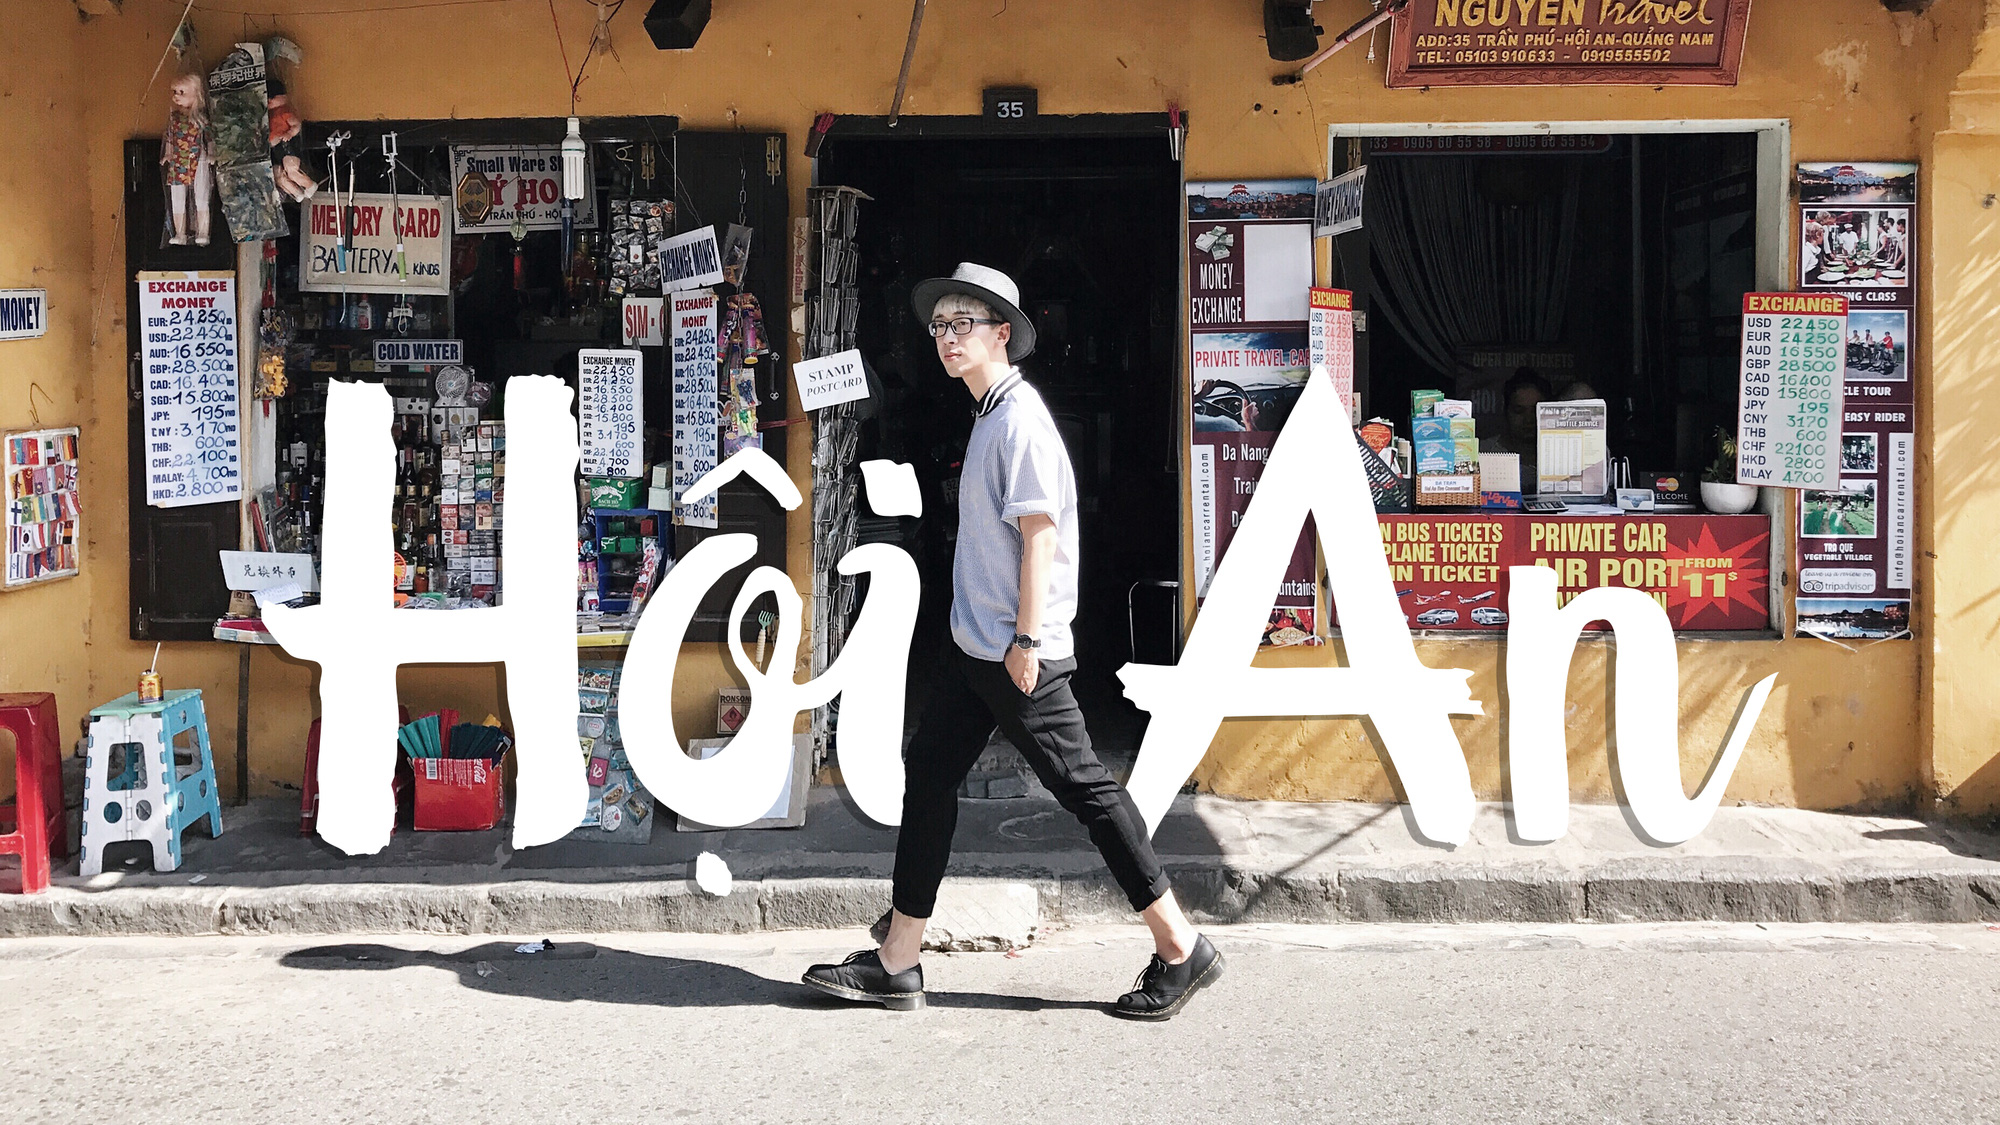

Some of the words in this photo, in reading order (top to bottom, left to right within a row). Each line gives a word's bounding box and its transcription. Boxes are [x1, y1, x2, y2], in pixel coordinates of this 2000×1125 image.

[1477, 27, 1518, 47] TRẦN
[1680, 32, 1713, 46] NAM
[1416, 51, 1450, 63] TEL:
[1455, 51, 1498, 63] 05103
[1501, 50, 1555, 63] 910633
[1581, 50, 1670, 62] 0919555502
[997, 101, 1024, 118] 35
[1457, 137, 1472, 148] 55
[1477, 136, 1492, 148] 58
[467, 157, 504, 173] Small
[508, 156, 546, 173] Ware
[392, 207, 440, 238] CARD
[312, 244, 393, 274] BATERY
[691, 238, 719, 275] MONEY
[1200, 263, 1234, 290] MONEY
[148, 281, 228, 293] EXCHANGE
[161, 297, 216, 309] MONEY
[675, 297, 713, 311] EXCHANGE
[1312, 290, 1351, 309] EXCHANGE
[1865, 291, 1897, 302] CLASS
[1192, 297, 1242, 324] EXCHANGE
[1748, 296, 1844, 313] EXCHANGE
[0, 297, 40, 331] MONEY
[625, 304, 648, 339] SIM
[681, 315, 708, 328] MONEY
[1747, 317, 1772, 328] USD
[1781, 317, 1840, 332] 22450
[1747, 331, 1771, 341] EUR
[1780, 332, 1840, 345] 24250
[378, 343, 410, 360] COLD
[412, 343, 459, 360] WATER
[1195, 350, 1240, 368] PRIVATE
[1244, 348, 1285, 367] TRAVEL
[1746, 345, 1771, 355] AUD
[1780, 346, 1837, 358] 16550
[583, 356, 613, 365] EXCHANGE
[614, 357, 635, 366] MONEY
[1746, 359, 1771, 369] GBP
[1778, 359, 1836, 372] 28500
[808, 363, 854, 382] STAMP
[1745, 372, 1770, 382] CAD
[1778, 374, 1831, 386] 16400
[806, 377, 863, 397] POSTCARD
[1745, 386, 1769, 396] SGD
[1777, 387, 1831, 399] 15800
[1863, 386, 1891, 396] TOUR
[191, 404, 225, 421] 195
[1744, 400, 1766, 410] JPY
[1797, 402, 1829, 414] 195
[1743, 413, 1768, 424] CNY
[1786, 415, 1828, 428] 3170
[1844, 412, 1870, 422] EASY
[1874, 412, 1906, 422] RIDER
[613, 422, 635, 433] 195
[1743, 427, 1766, 438] THB
[1796, 430, 1827, 441] 600
[195, 436, 225, 449] 600
[615, 440, 635, 449] 600
[1742, 441, 1766, 451] CHF
[1775, 442, 1826, 456] 22100
[1222, 443, 1236, 461] Da
[1241, 443, 1270, 465] Nang
[1741, 454, 1766, 465] HKD
[1784, 457, 1825, 469] 2800
[1741, 468, 1772, 479] MLAY
[1782, 471, 1824, 483] 4700
[1396, 522, 1430, 542] BUS
[1434, 522, 1503, 543] TICKETS
[1530, 522, 1617, 552] PRIVATE
[1623, 522, 1667, 552] CAR
[1440, 543, 1499, 563] TICKET
[1823, 543, 1837, 552] TRA
[1839, 543, 1854, 553] QUE
[1685, 557, 1733, 569] FROM
[1804, 553, 1842, 561] VEGETABLE
[244, 564, 296, 578] 兑换外币
[1420, 565, 1500, 583] TICKET
[1600, 558, 1684, 588] PORT
[1825, 581, 1873, 591] tripadvisor
